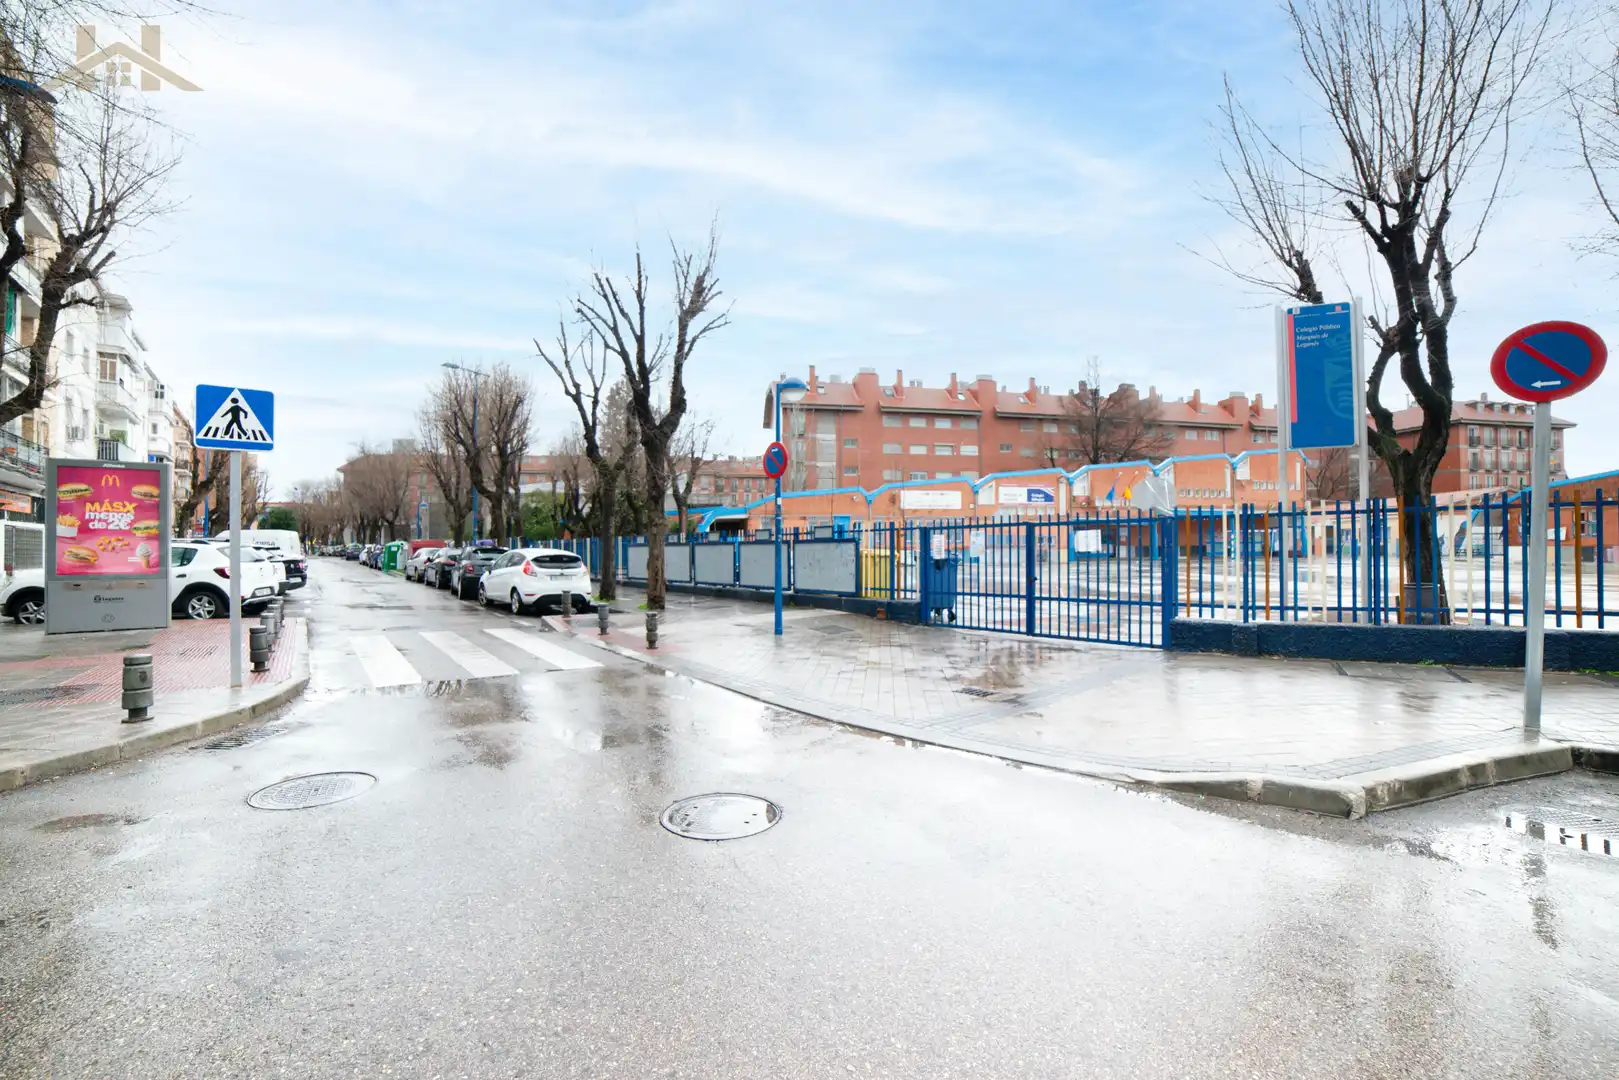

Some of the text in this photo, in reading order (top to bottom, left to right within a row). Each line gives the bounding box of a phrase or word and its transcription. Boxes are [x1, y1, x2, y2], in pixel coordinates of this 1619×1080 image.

[85, 512, 135, 521] menos
[88, 520, 131, 530] de 2€
